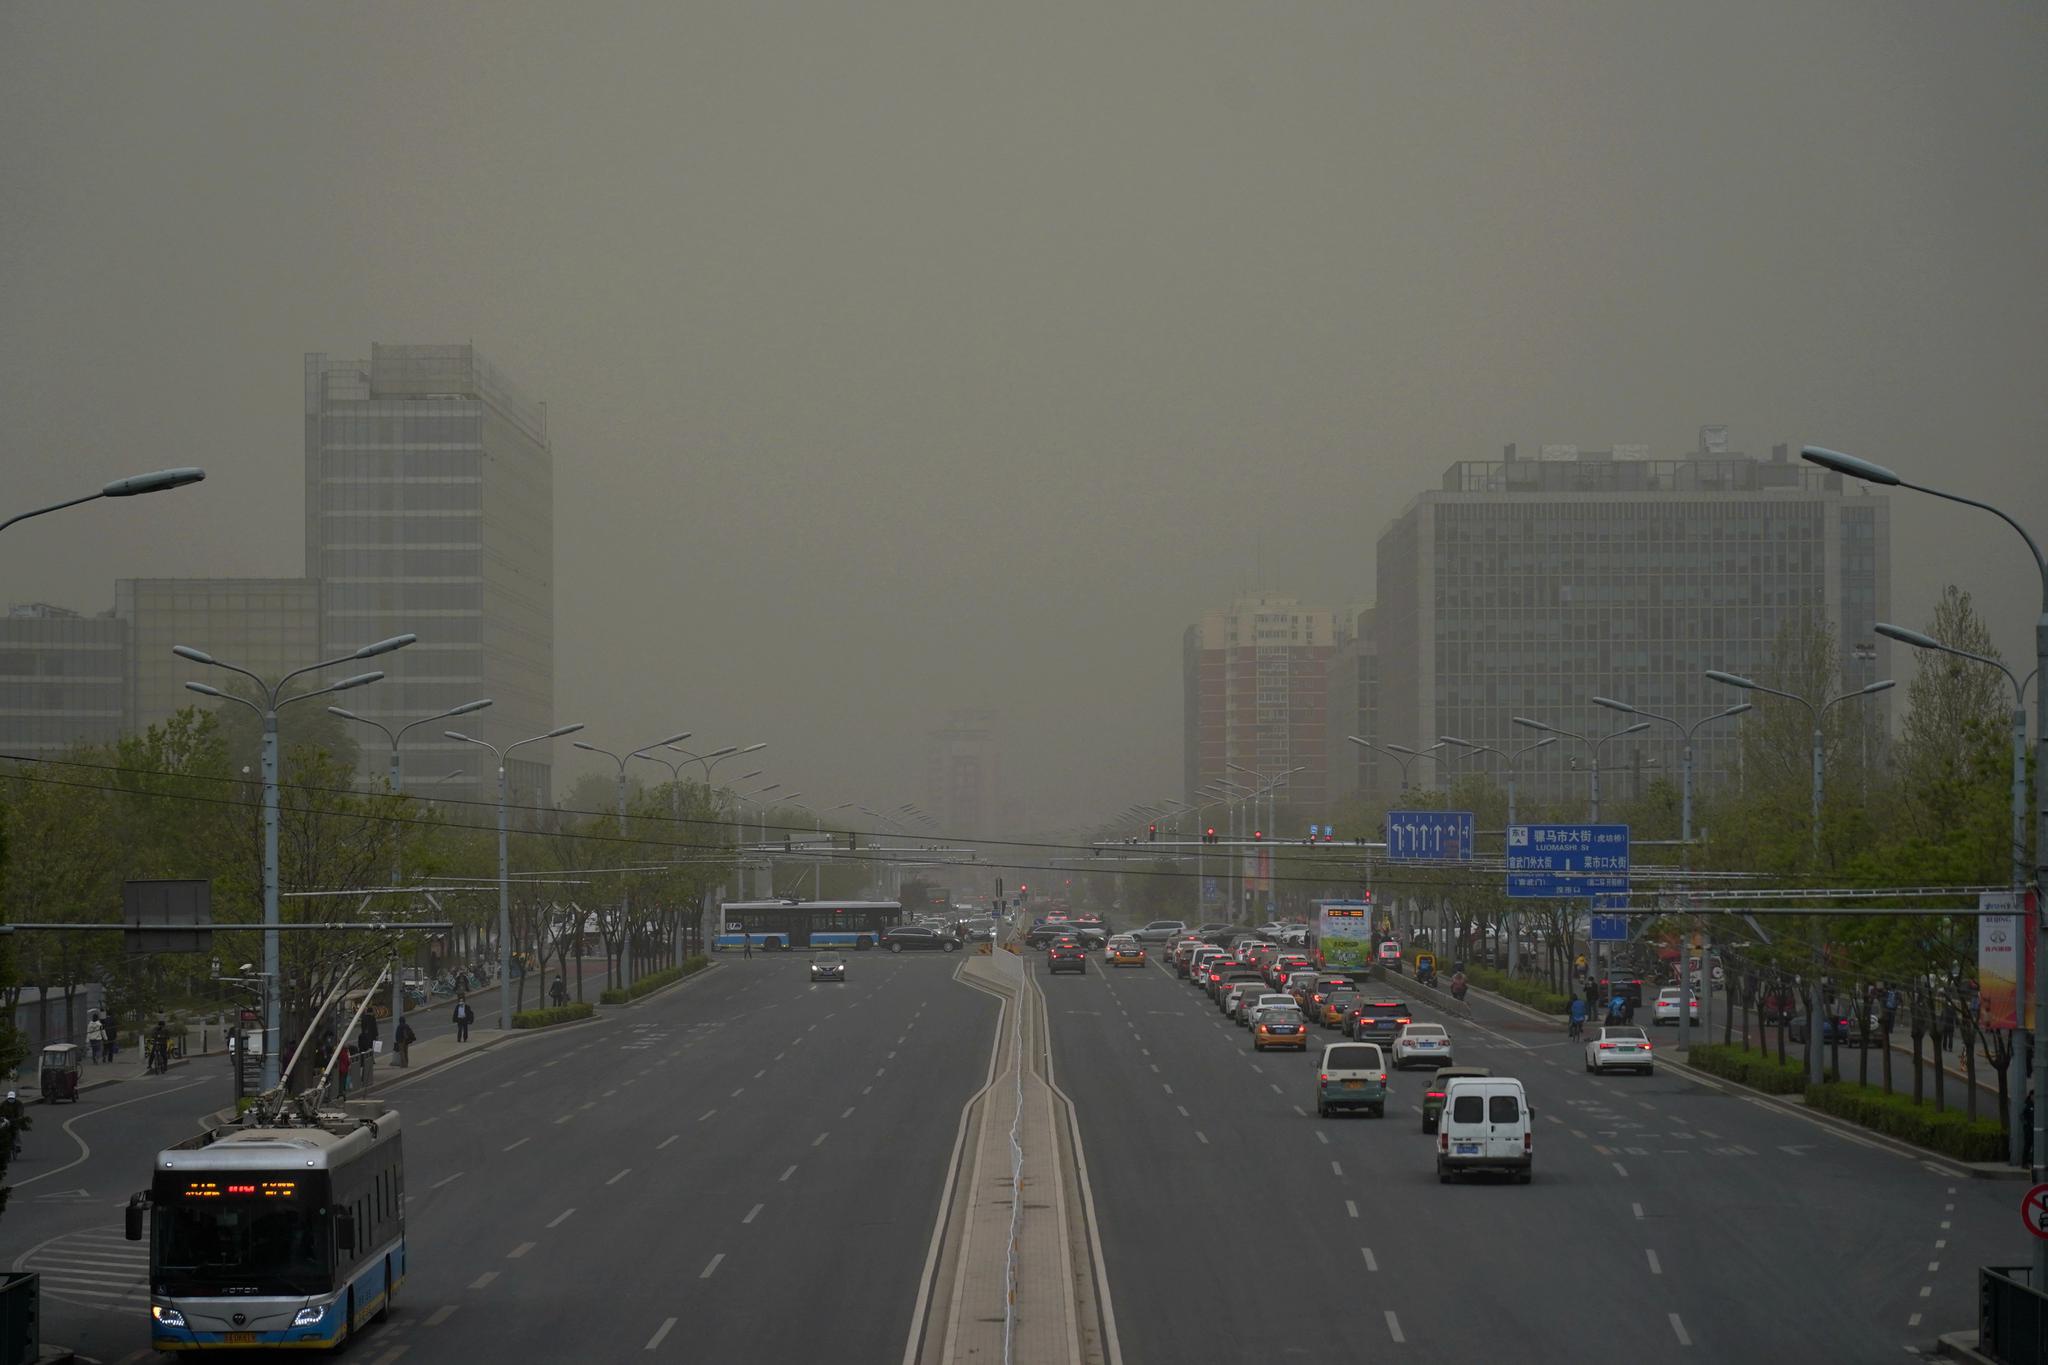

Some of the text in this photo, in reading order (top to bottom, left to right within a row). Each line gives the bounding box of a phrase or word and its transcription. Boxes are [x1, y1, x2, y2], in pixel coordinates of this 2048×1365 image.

[1534, 829, 1592, 843] 骡马市大街
[1509, 855, 1553, 870] 宣武门外大街
[1584, 855, 1627, 870] 菜市口大街
